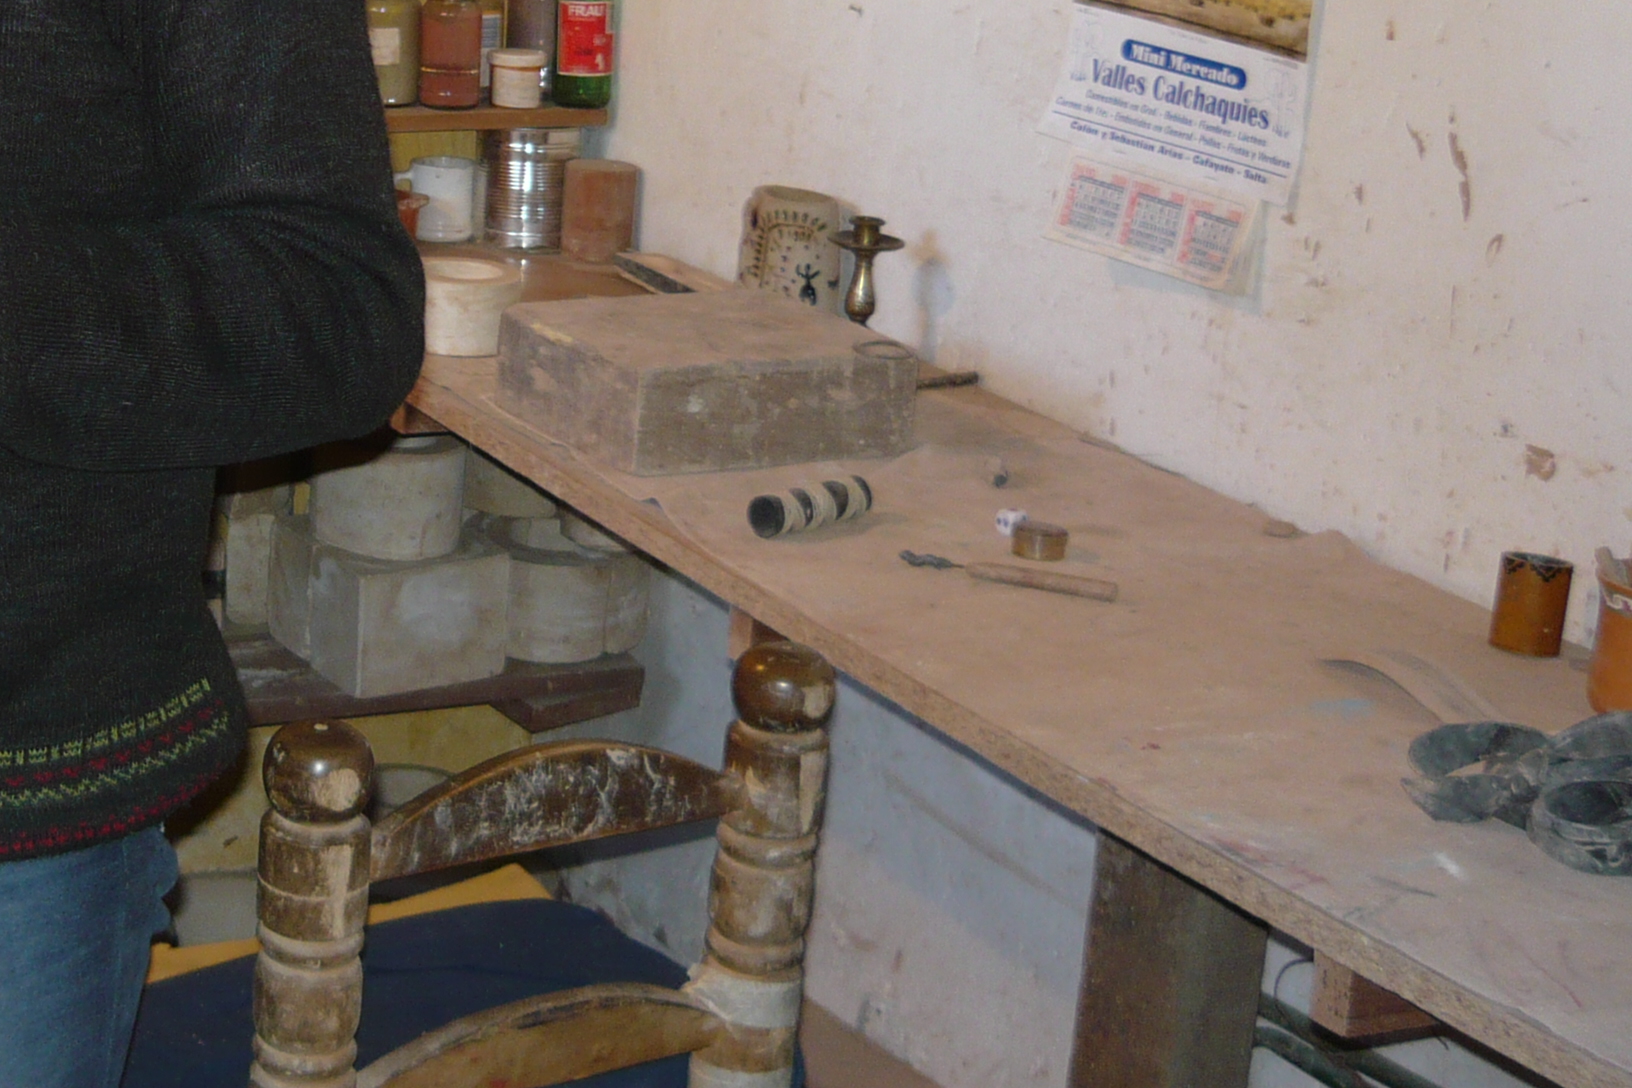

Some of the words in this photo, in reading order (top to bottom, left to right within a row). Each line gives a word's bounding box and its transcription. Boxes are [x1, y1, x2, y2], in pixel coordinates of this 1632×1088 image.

[1131, 43, 1166, 66] Mini
[1168, 53, 1240, 86] Mercado
[1092, 58, 1146, 96] Valles
[1152, 75, 1270, 130] Calchaquies
[1157, 145, 1184, 161] Arias
[1243, 168, 1268, 184] Salta
[1164, 125, 1193, 141] General
[1227, 143, 1250, 158] Frutas
[1257, 151, 1291, 169] Verduras
